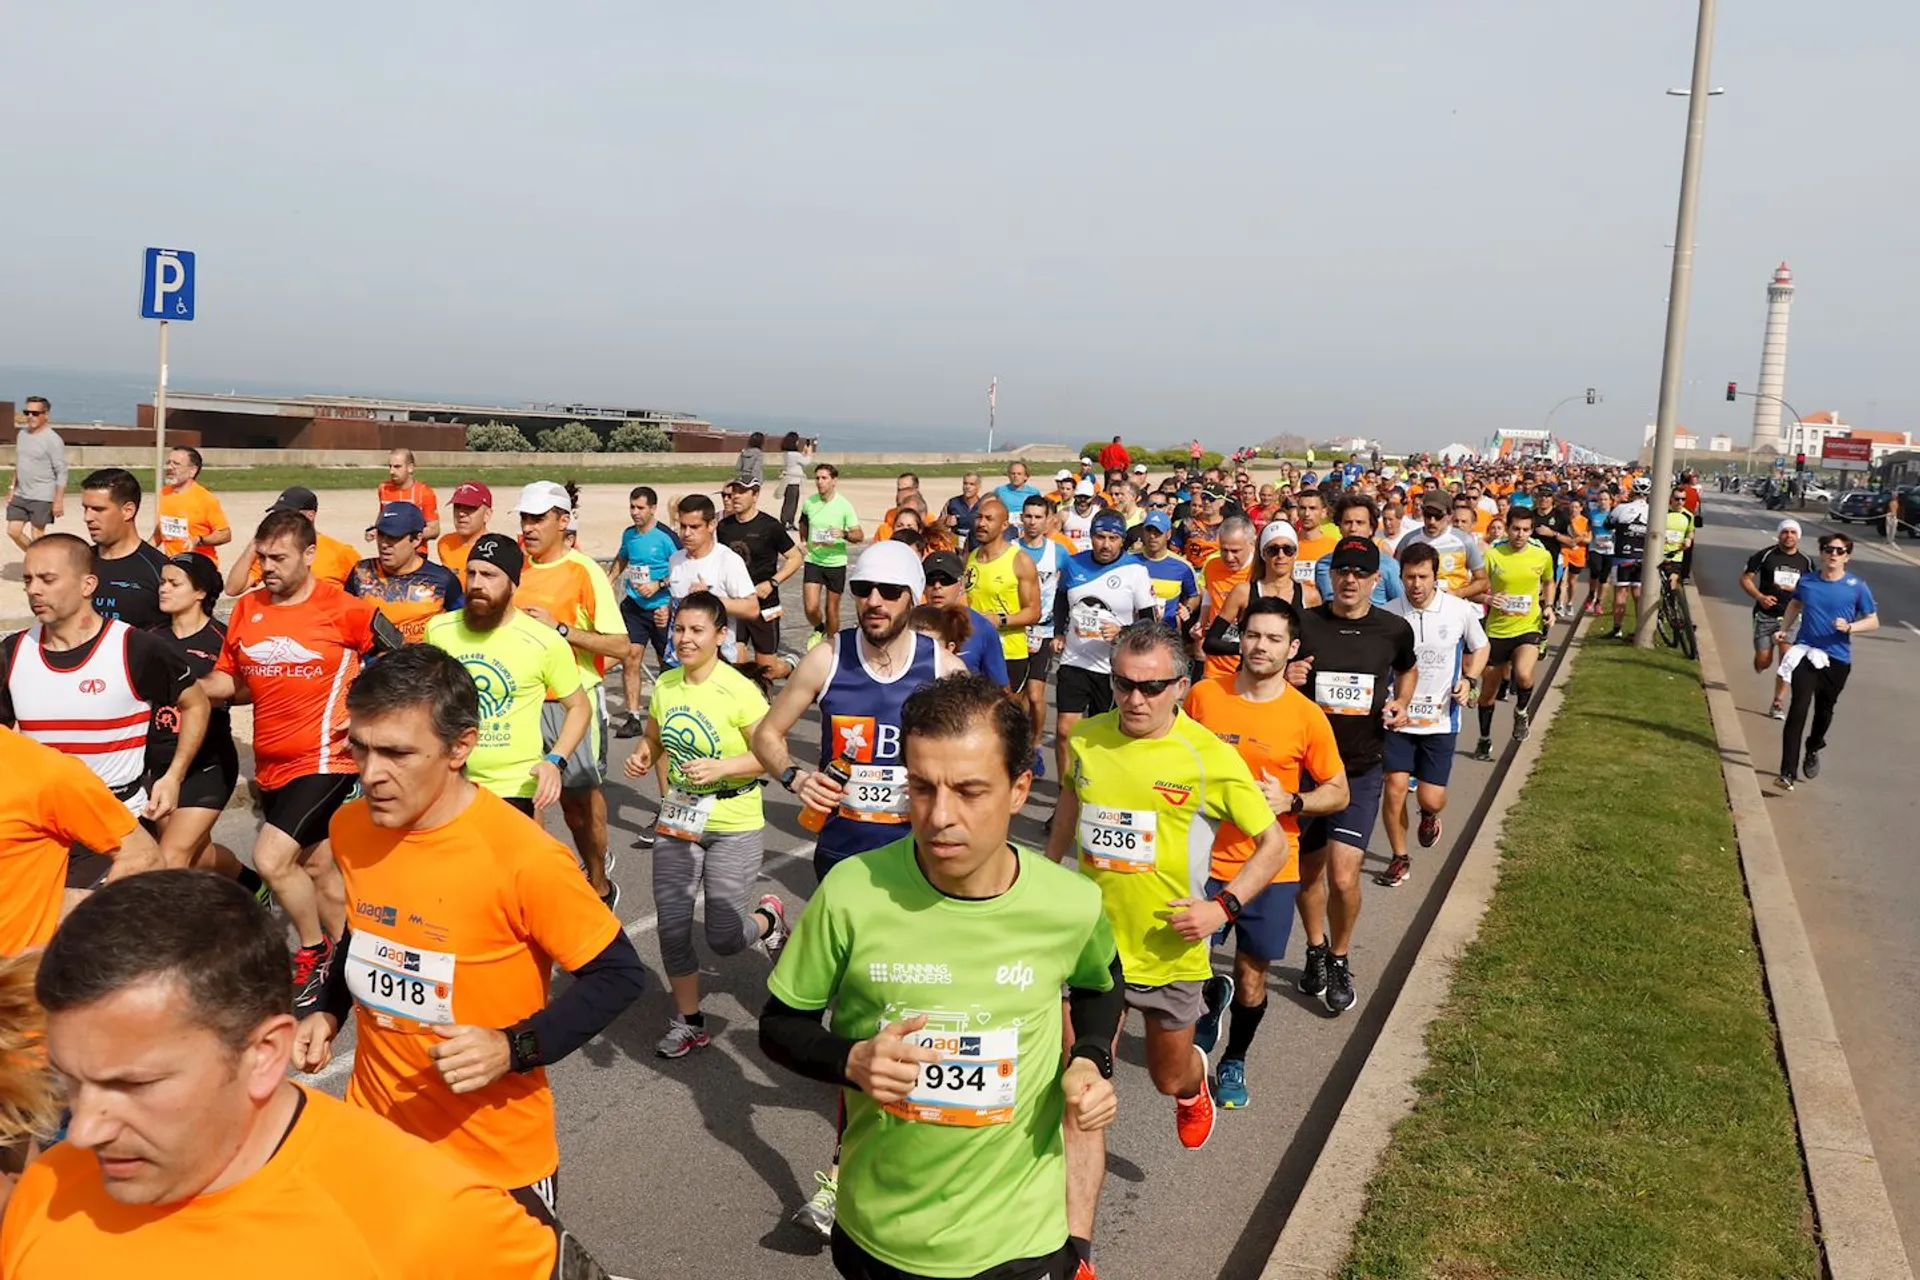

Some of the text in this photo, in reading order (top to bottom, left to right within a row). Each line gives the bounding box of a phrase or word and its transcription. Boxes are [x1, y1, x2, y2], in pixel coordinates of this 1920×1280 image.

[154, 255, 185, 313] P
[287, 665, 323, 679] LEÇA
[1328, 686, 1361, 701] 1692
[1409, 704, 1434, 715] 1602
[875, 723, 901, 759] B
[858, 786, 892, 803] 332
[1154, 780, 1194, 792] OUTPACE
[667, 806, 697, 824] 3114
[1091, 827, 1137, 850] 2536
[892, 963, 948, 974] RUNNING
[995, 960, 1034, 992] edp
[366, 969, 426, 1006] 1918
[889, 973, 952, 985] WONDERS
[914, 1064, 986, 1092] 934
